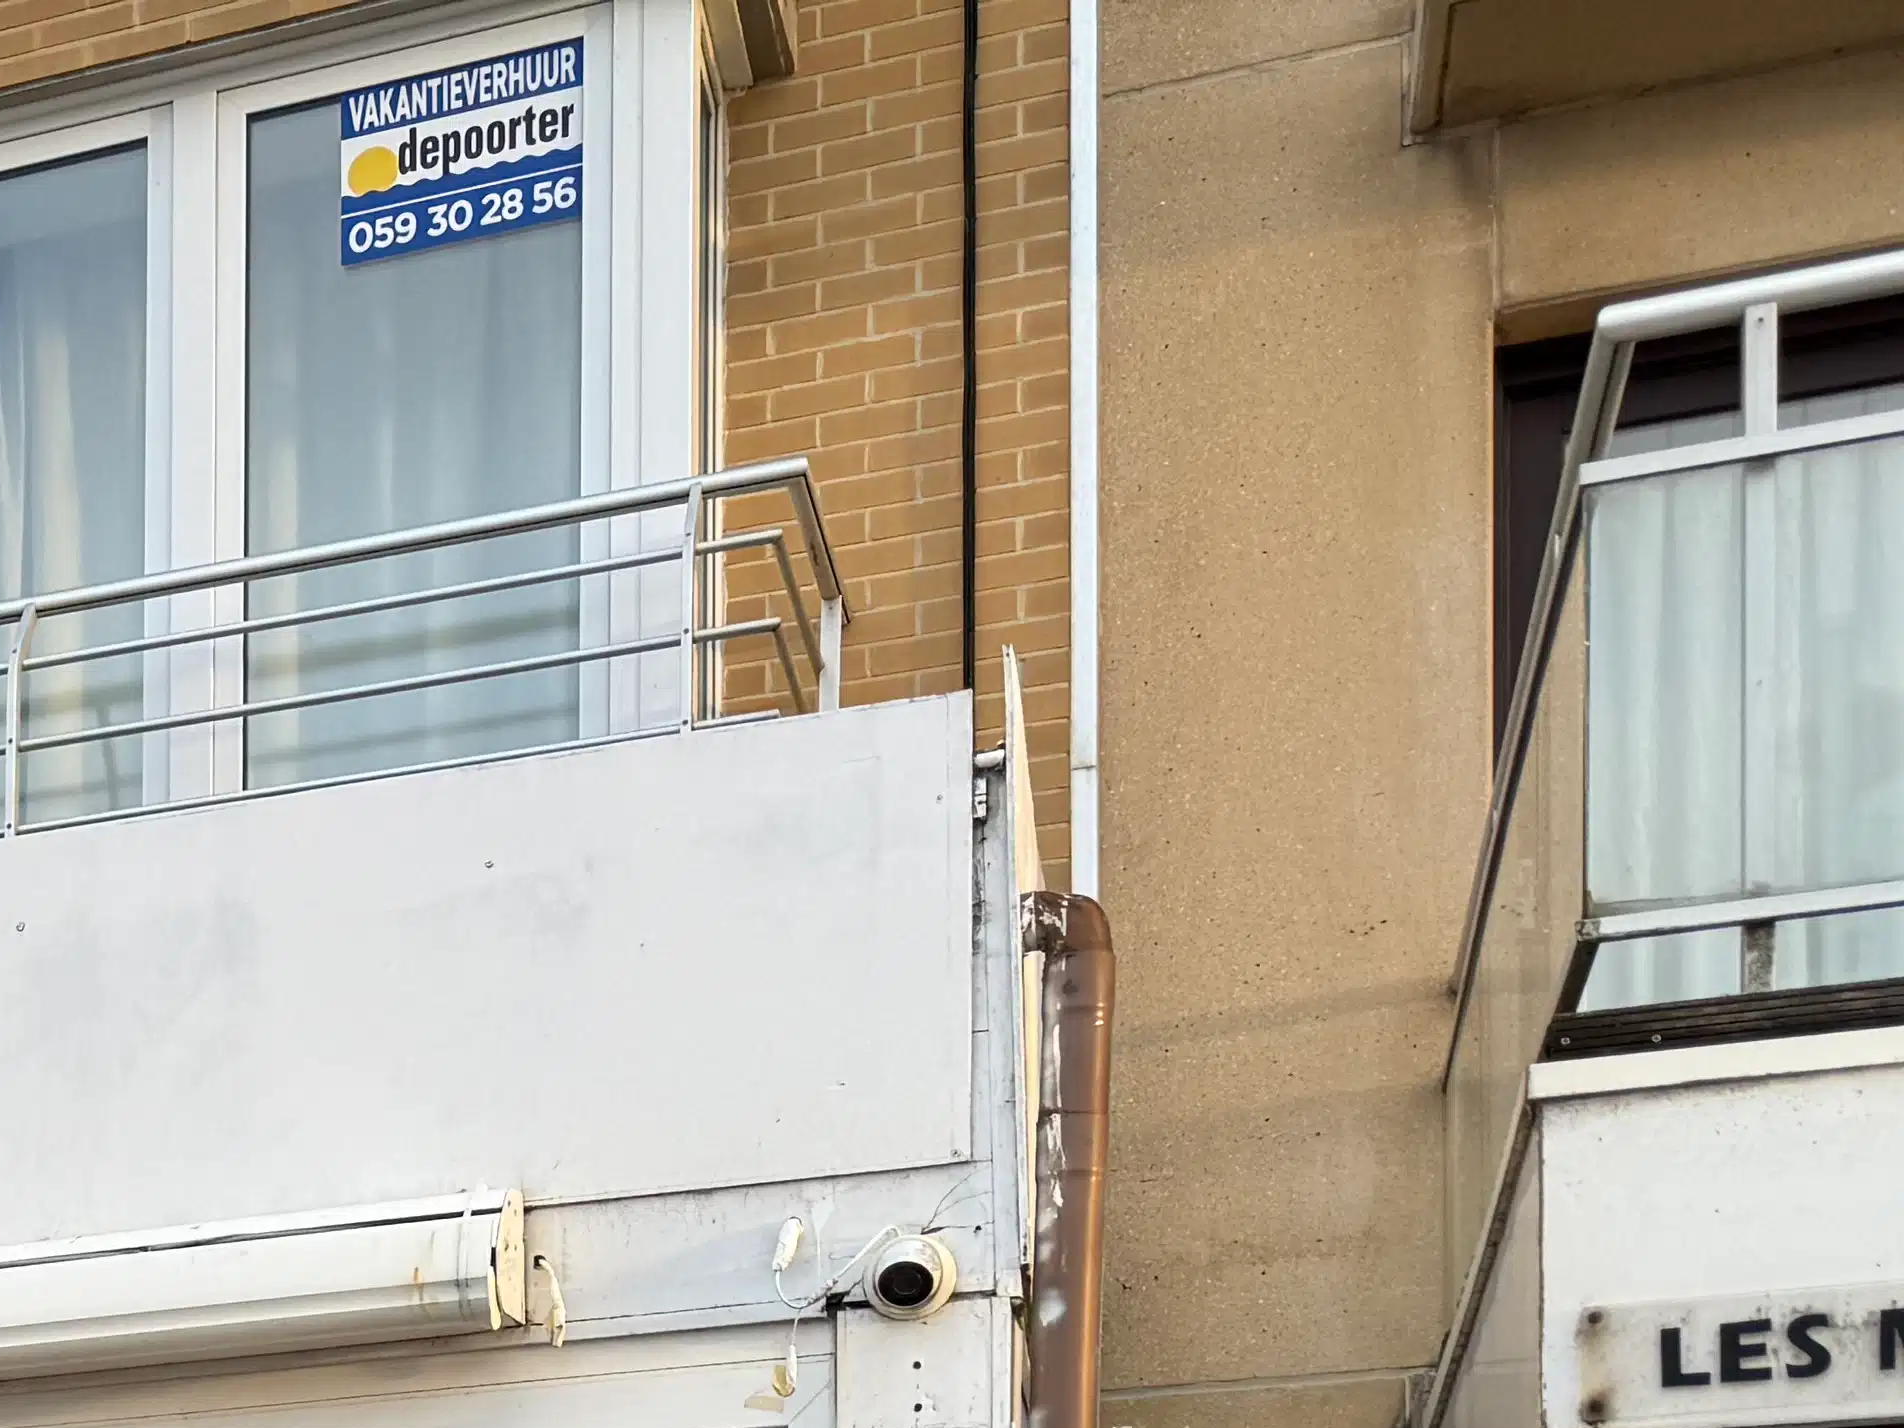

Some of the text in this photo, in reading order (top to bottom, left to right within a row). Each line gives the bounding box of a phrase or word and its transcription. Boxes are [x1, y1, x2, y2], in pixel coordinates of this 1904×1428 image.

[348, 46, 576, 132] VAKANTIEVERHUUR
[397, 103, 575, 174] depoorter
[348, 176, 577, 254] 059 30 28 56
[1660, 1313, 1832, 1388] LES
